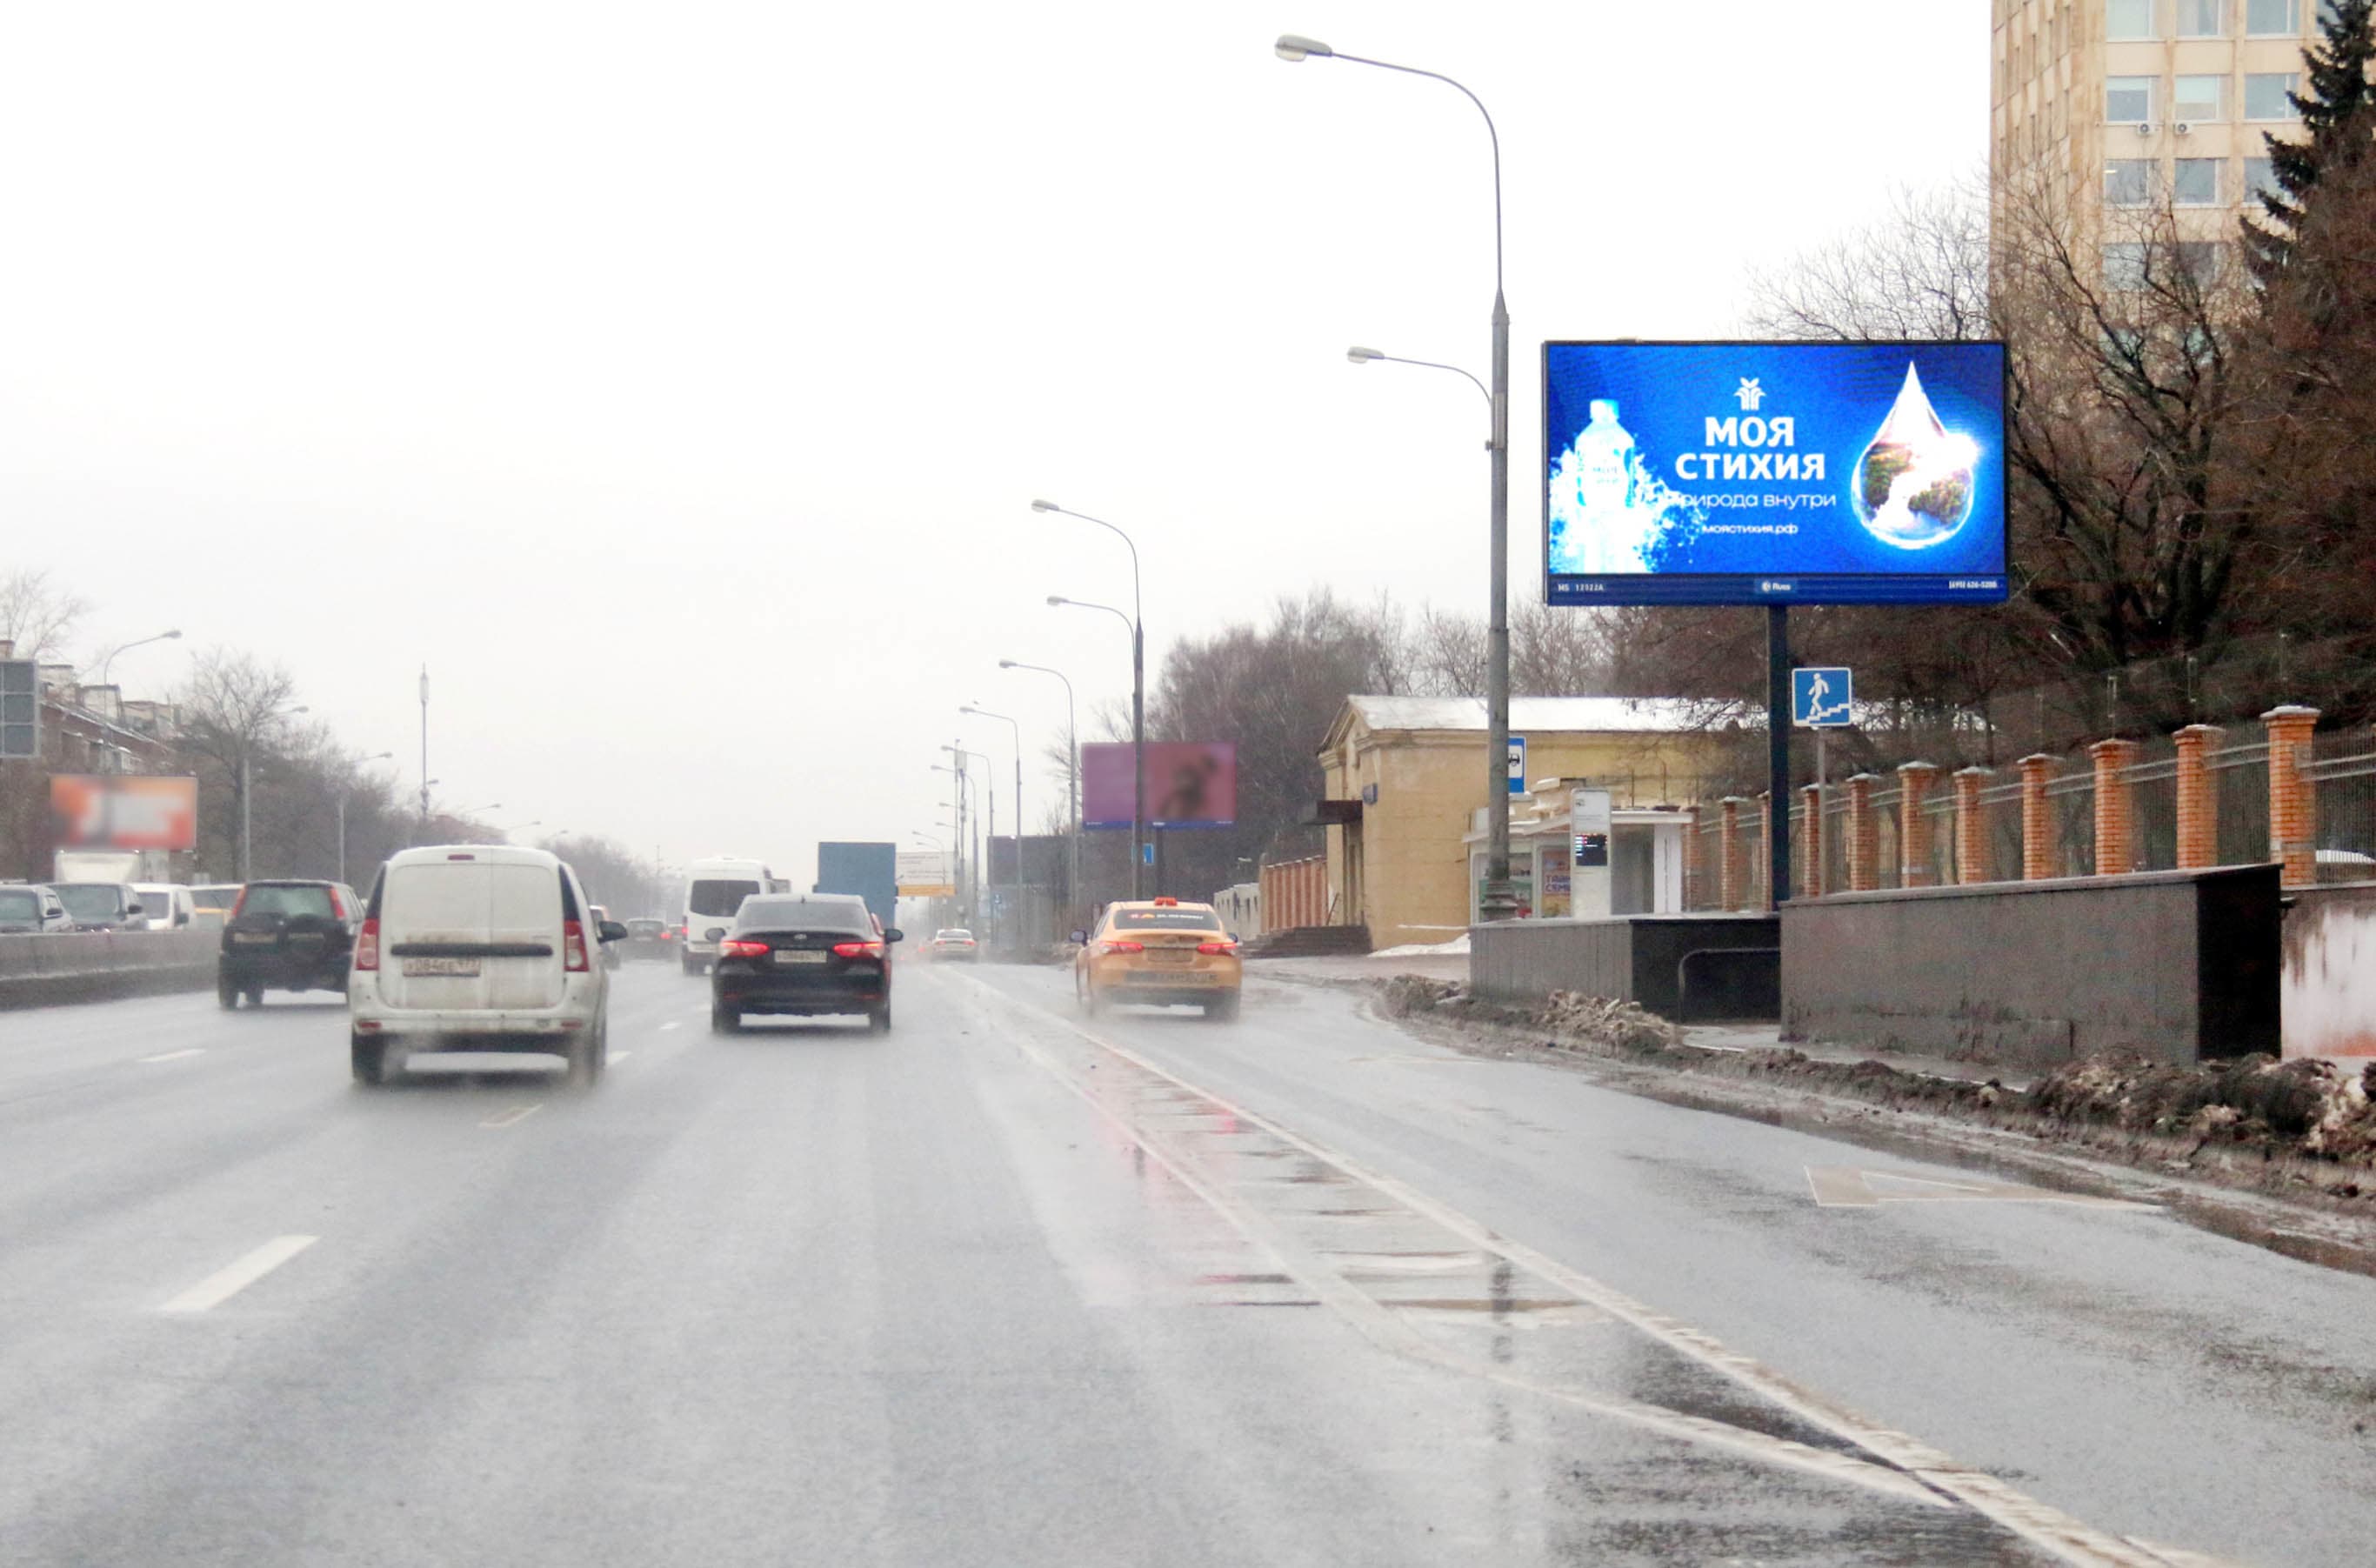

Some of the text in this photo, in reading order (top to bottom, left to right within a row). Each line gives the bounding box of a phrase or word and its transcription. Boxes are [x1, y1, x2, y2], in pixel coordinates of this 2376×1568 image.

[1705, 416, 1794, 448] МОЯ
[1675, 453, 1825, 480] СТИХИЯ
[1763, 494, 1837, 510] внутри
[1701, 524, 1799, 535] моястихия.рф
